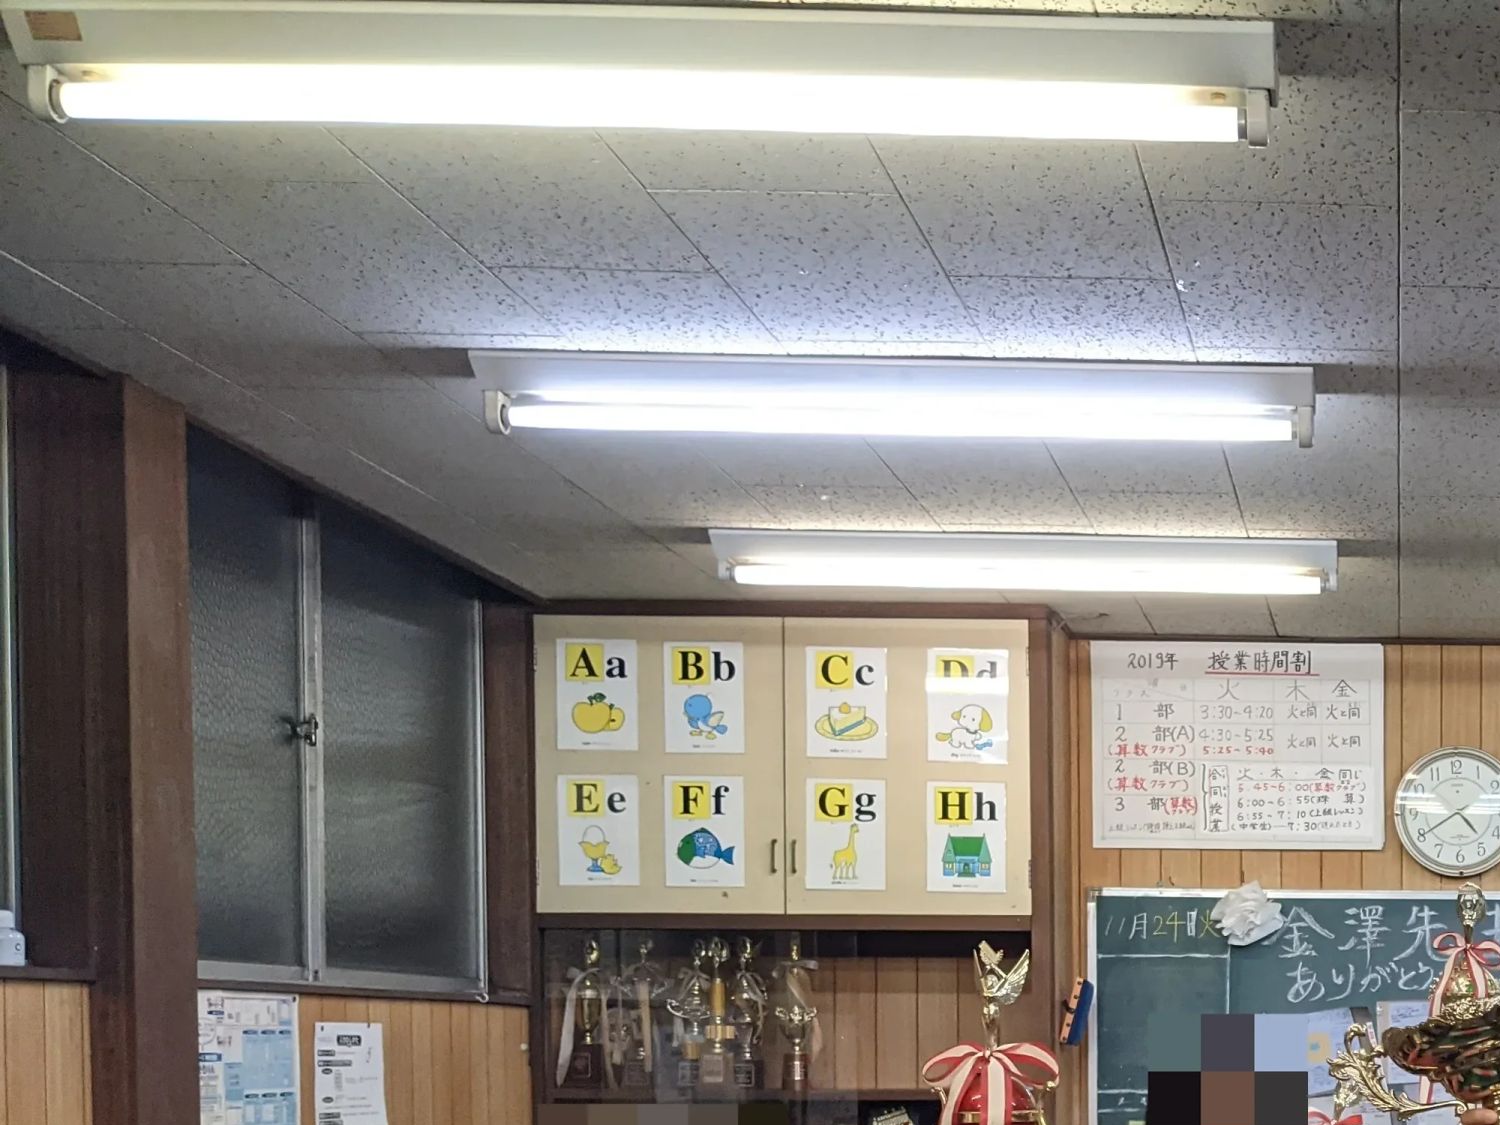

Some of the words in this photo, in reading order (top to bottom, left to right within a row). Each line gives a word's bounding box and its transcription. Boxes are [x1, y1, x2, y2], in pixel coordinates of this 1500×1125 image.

[569, 647, 628, 679] Aa
[678, 650, 736, 682] Bb
[820, 654, 875, 686] Cc
[1128, 652, 1179, 671] 2019年
[1208, 650, 1311, 674] 授業時間割
[1217, 679, 1240, 700] 火
[1285, 679, 1310, 701] 木
[1331, 679, 1358, 698] 金
[573, 783, 626, 814] Ee
[680, 785, 729, 816] Ff
[818, 788, 877, 823] Gg
[937, 791, 998, 822] Hh
